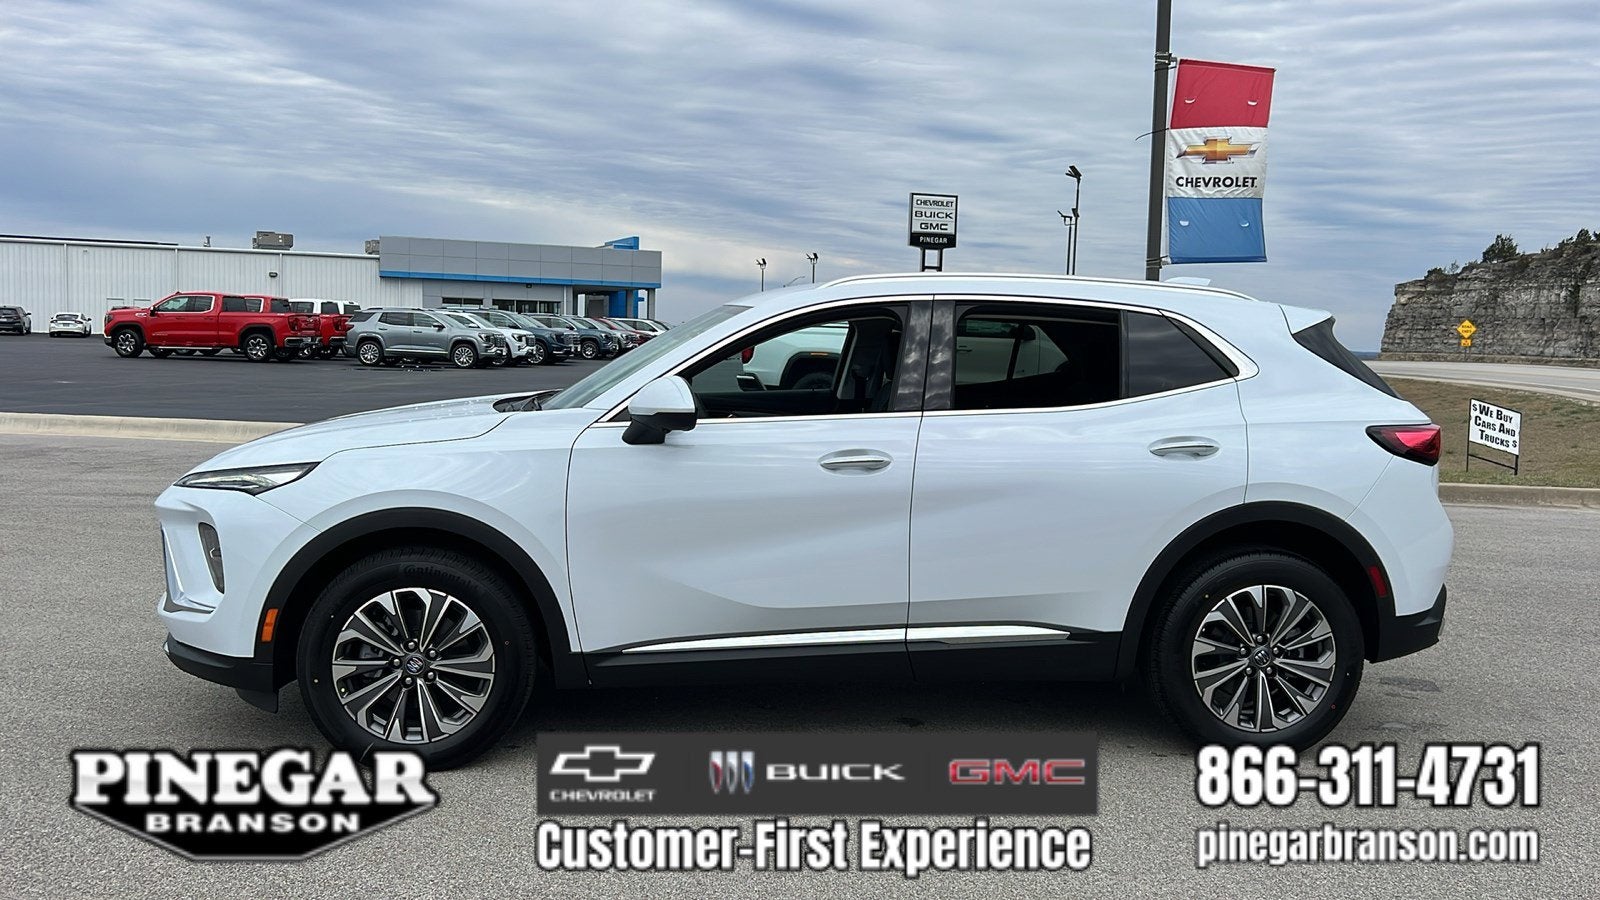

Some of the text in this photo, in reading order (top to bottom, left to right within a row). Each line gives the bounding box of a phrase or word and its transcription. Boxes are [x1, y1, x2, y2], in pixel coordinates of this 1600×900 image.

[1175, 176, 1257, 188] CHEVROLET
[915, 199, 954, 207] CHEVROLET
[914, 210, 954, 220] BUICK
[920, 222, 948, 230] GMC
